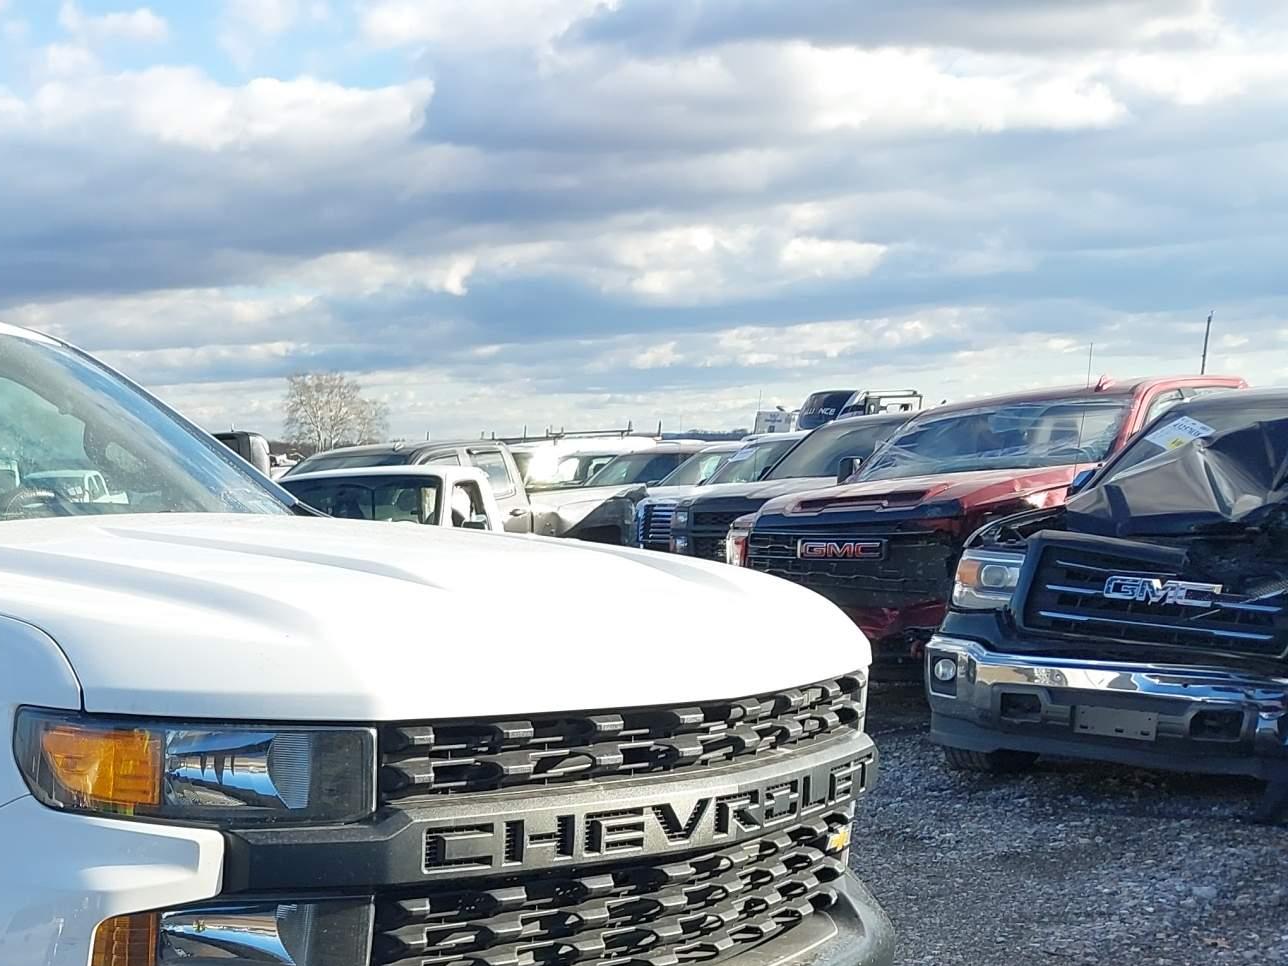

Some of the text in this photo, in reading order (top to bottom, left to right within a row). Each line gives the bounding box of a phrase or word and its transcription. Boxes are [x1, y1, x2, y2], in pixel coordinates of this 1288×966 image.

[802, 542, 880, 558] GMC
[1103, 575, 1223, 608] GMC
[422, 751, 874, 875] CHEVROLET
